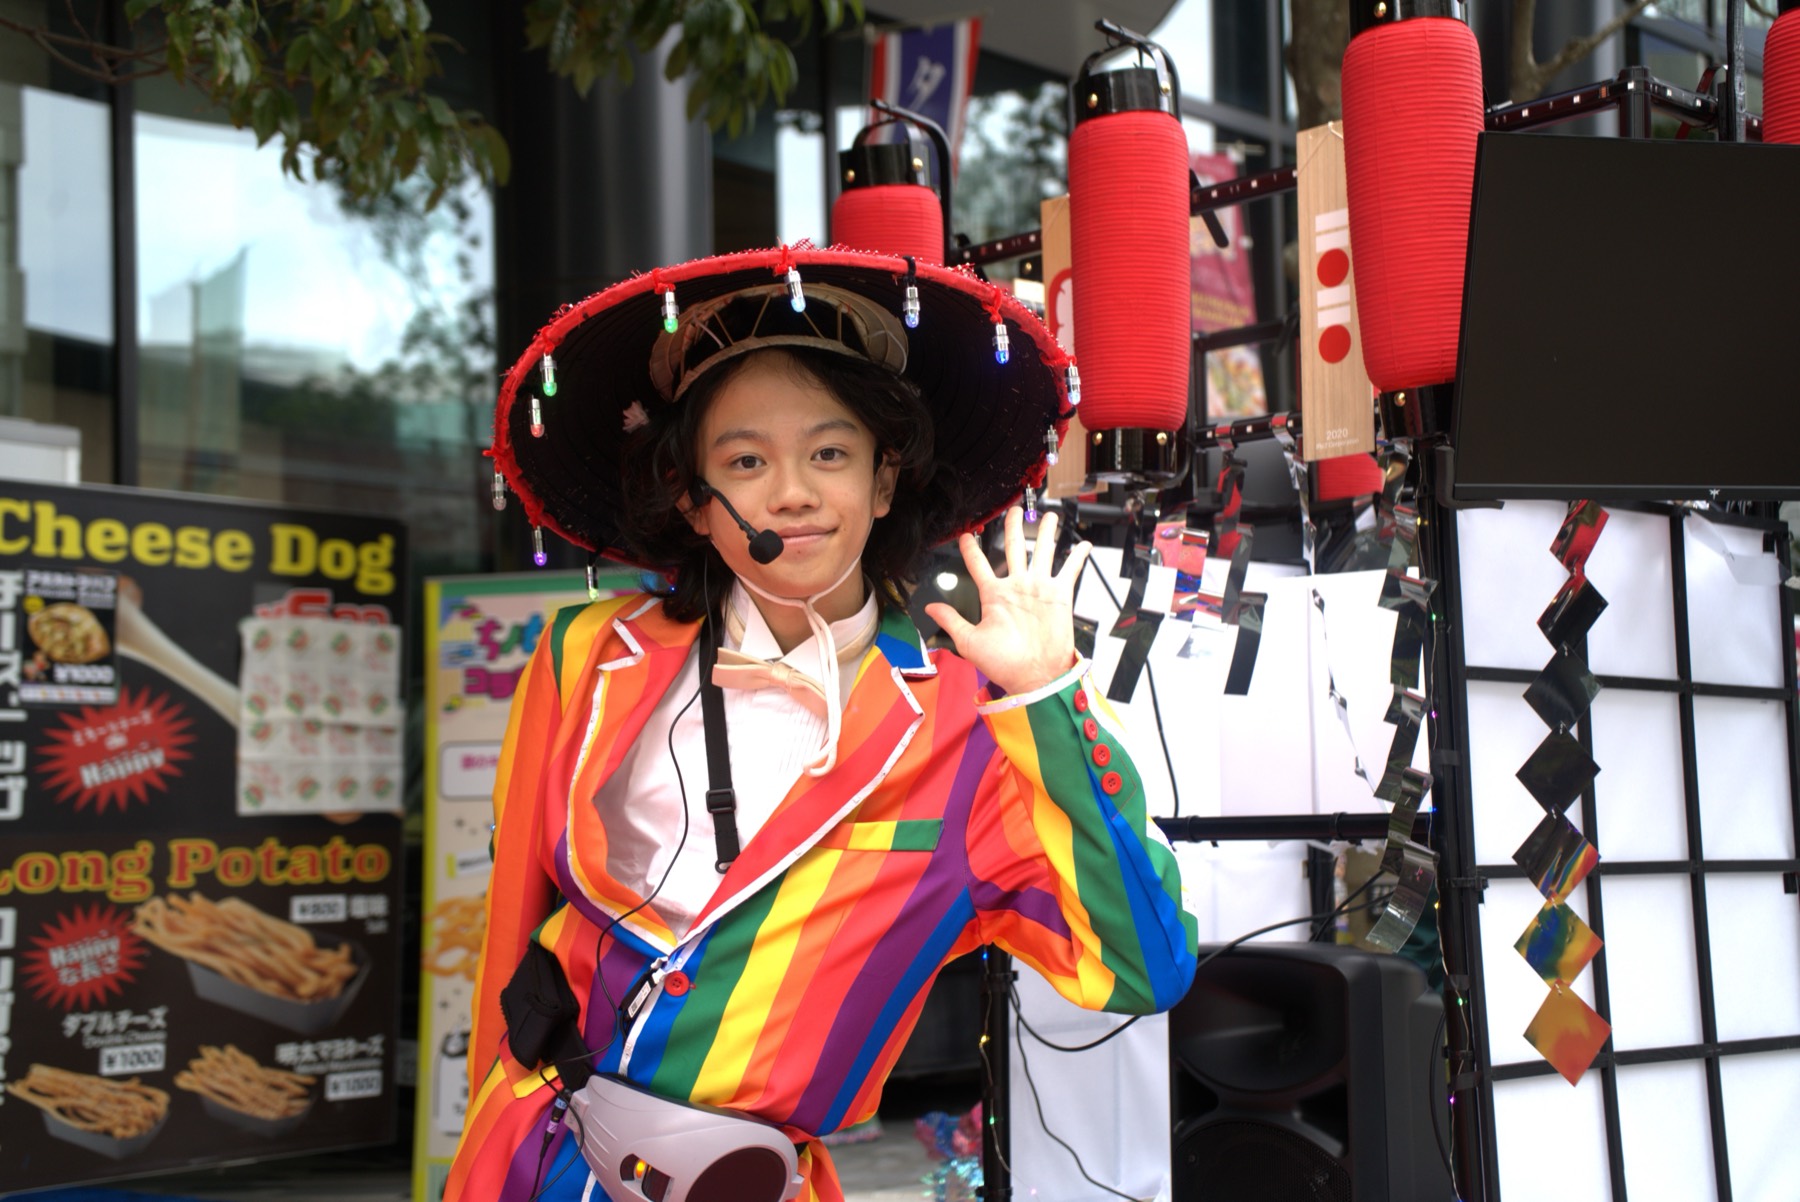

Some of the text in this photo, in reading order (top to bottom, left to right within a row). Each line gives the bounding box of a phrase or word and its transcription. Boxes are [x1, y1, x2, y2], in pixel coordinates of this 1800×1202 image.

[1326, 428, 1348, 440] 2020
[0, 498, 395, 595] Cheese Dog
[0, 836, 391, 902] ong Potato
[62, 1005, 168, 1038] ダブルチーズ
